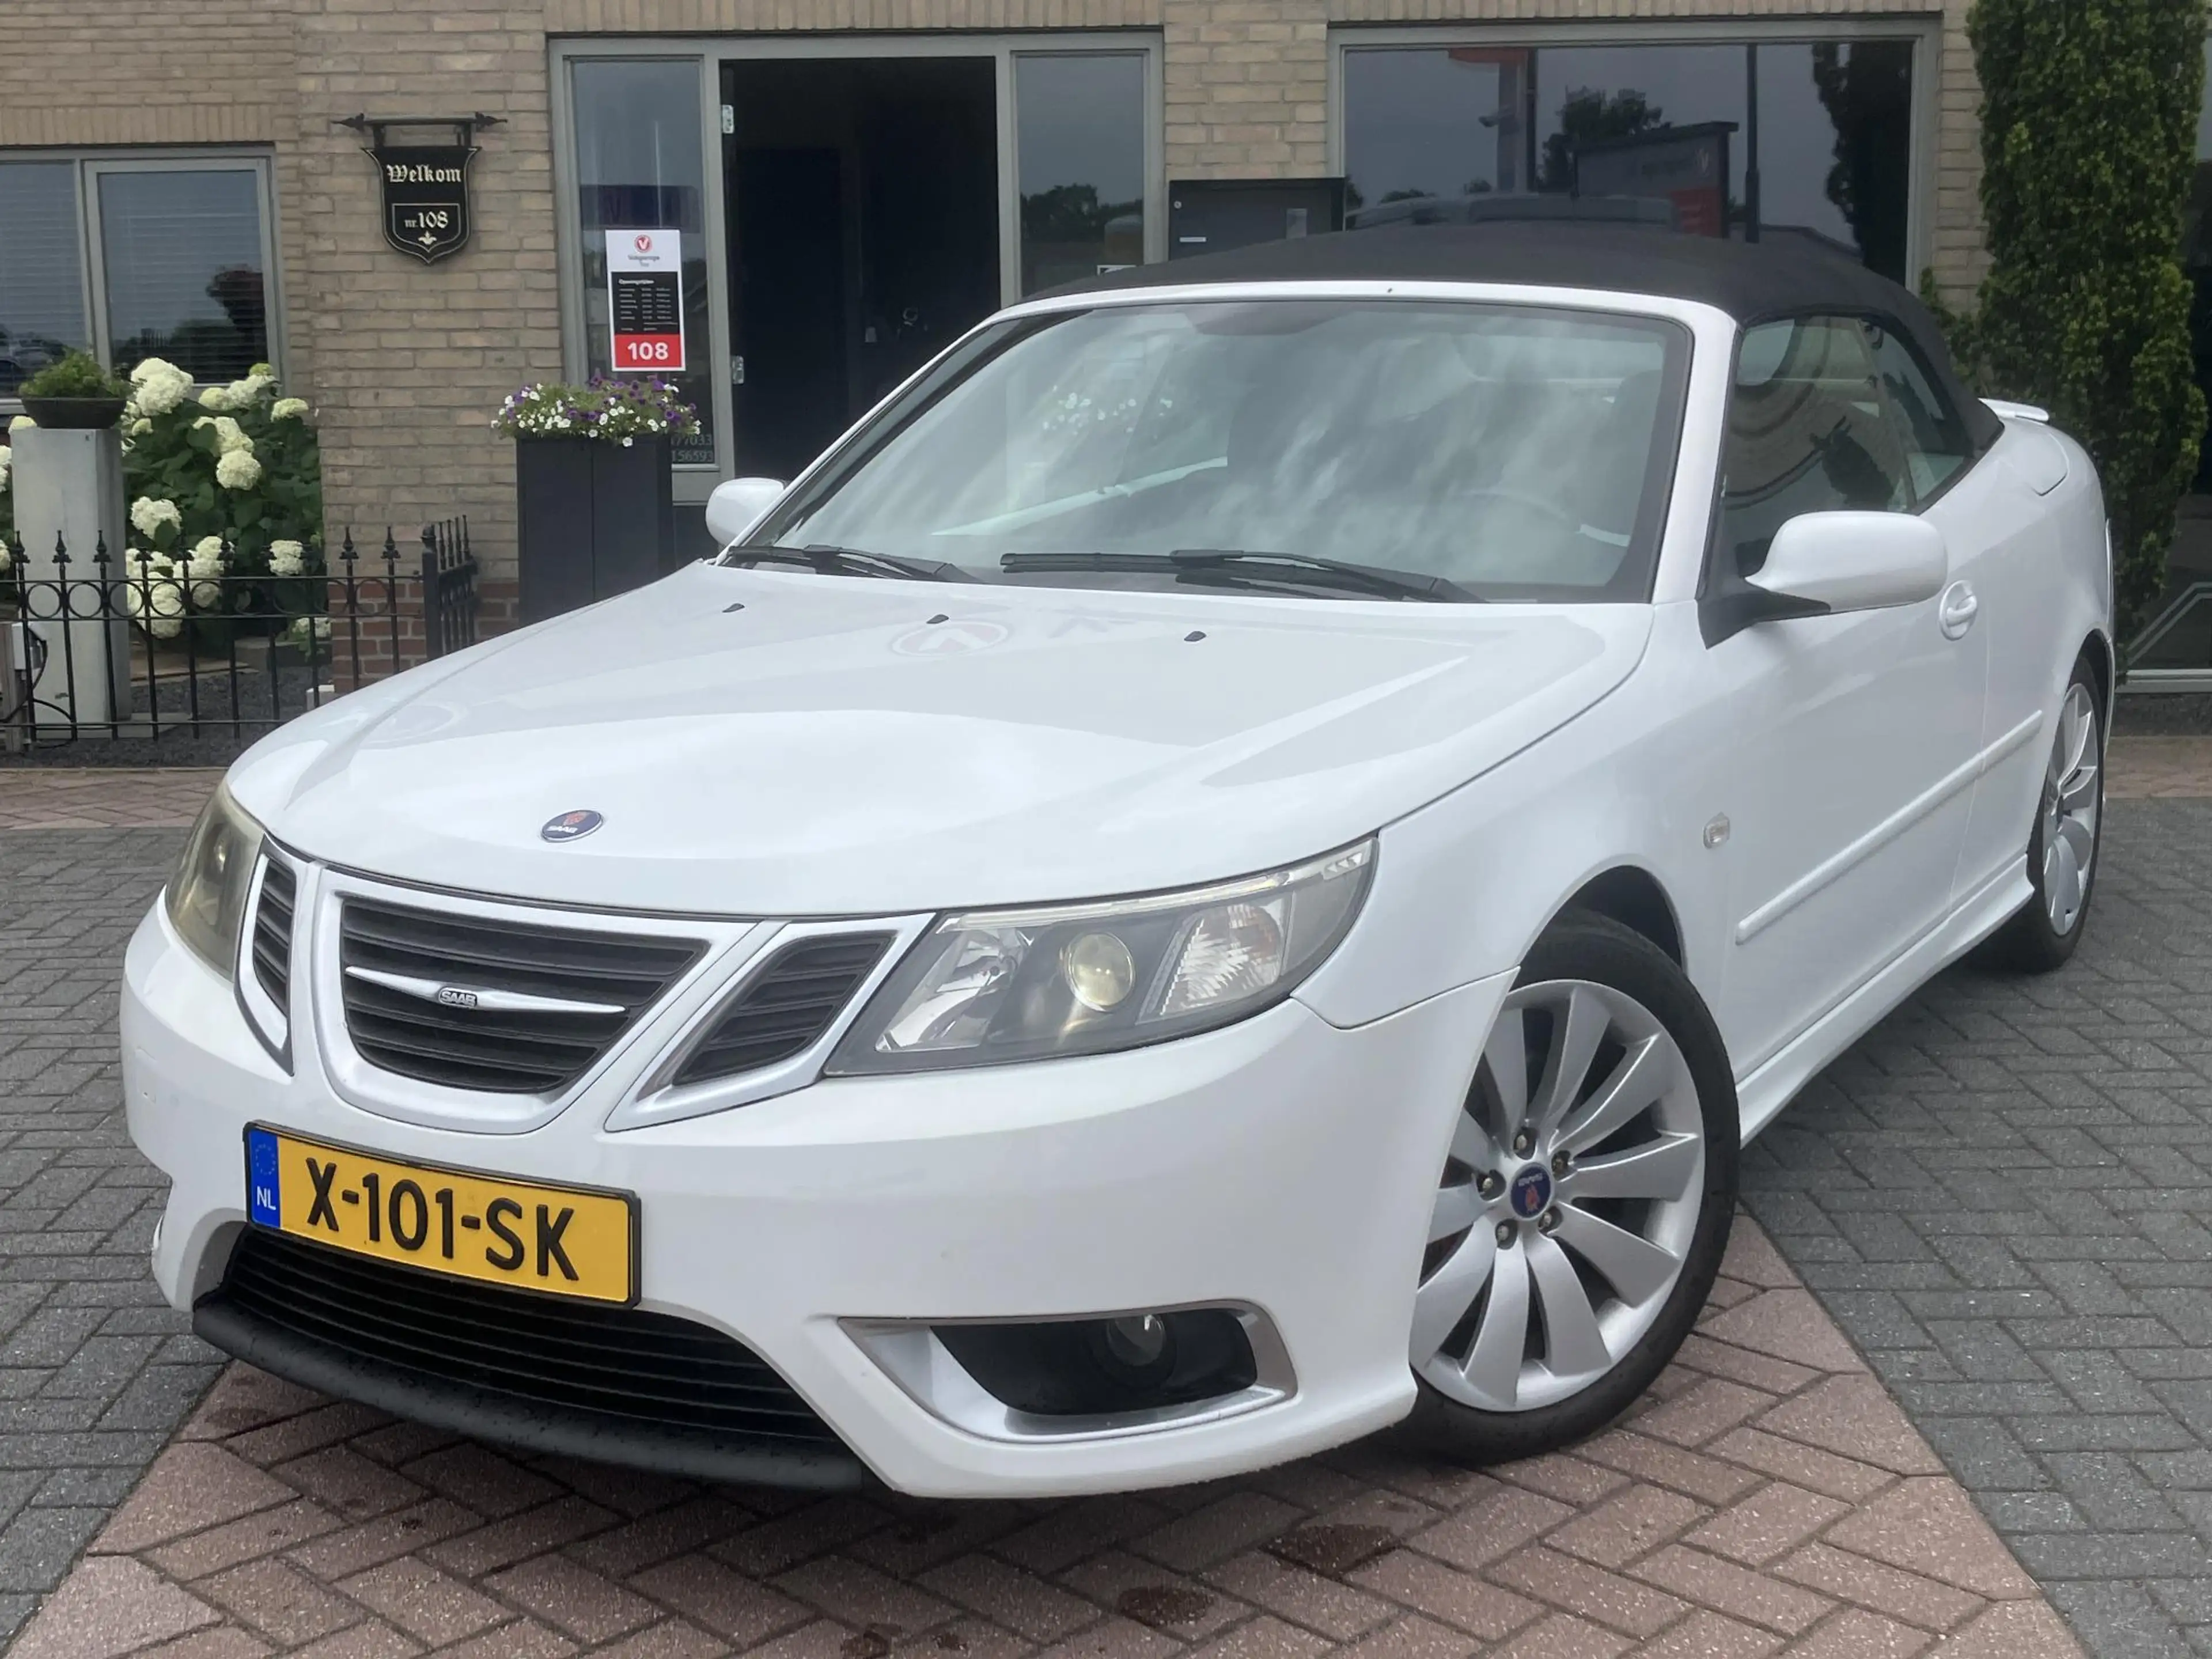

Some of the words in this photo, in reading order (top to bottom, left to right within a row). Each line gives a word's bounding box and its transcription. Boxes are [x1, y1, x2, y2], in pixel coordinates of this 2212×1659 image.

[387, 164, 461, 183] Welkom
[627, 342, 669, 361] 108
[441, 990, 476, 1007] SAAB
[256, 1185, 276, 1210] NL
[305, 1157, 579, 1281] X-101-SK
